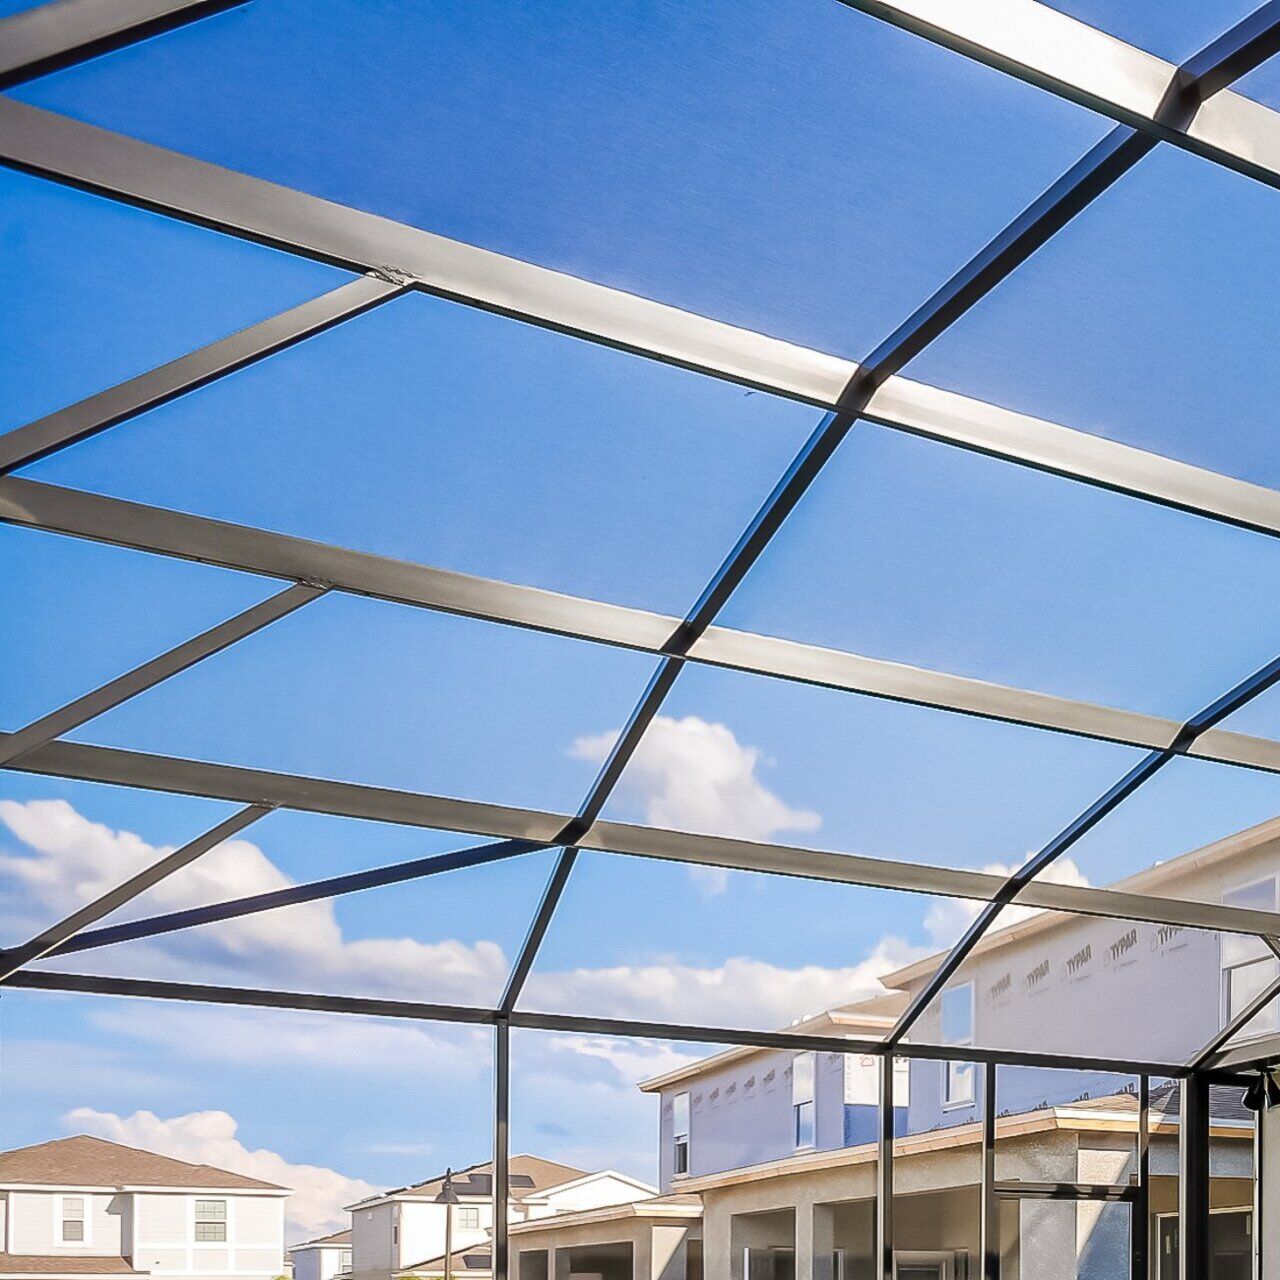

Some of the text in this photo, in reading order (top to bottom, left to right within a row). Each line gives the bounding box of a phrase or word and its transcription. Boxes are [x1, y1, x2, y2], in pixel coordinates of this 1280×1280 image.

[1066, 944, 1093, 975] TYPAR
[1109, 927, 1139, 961] TYPAR
[1026, 959, 1051, 989] TYPAR
